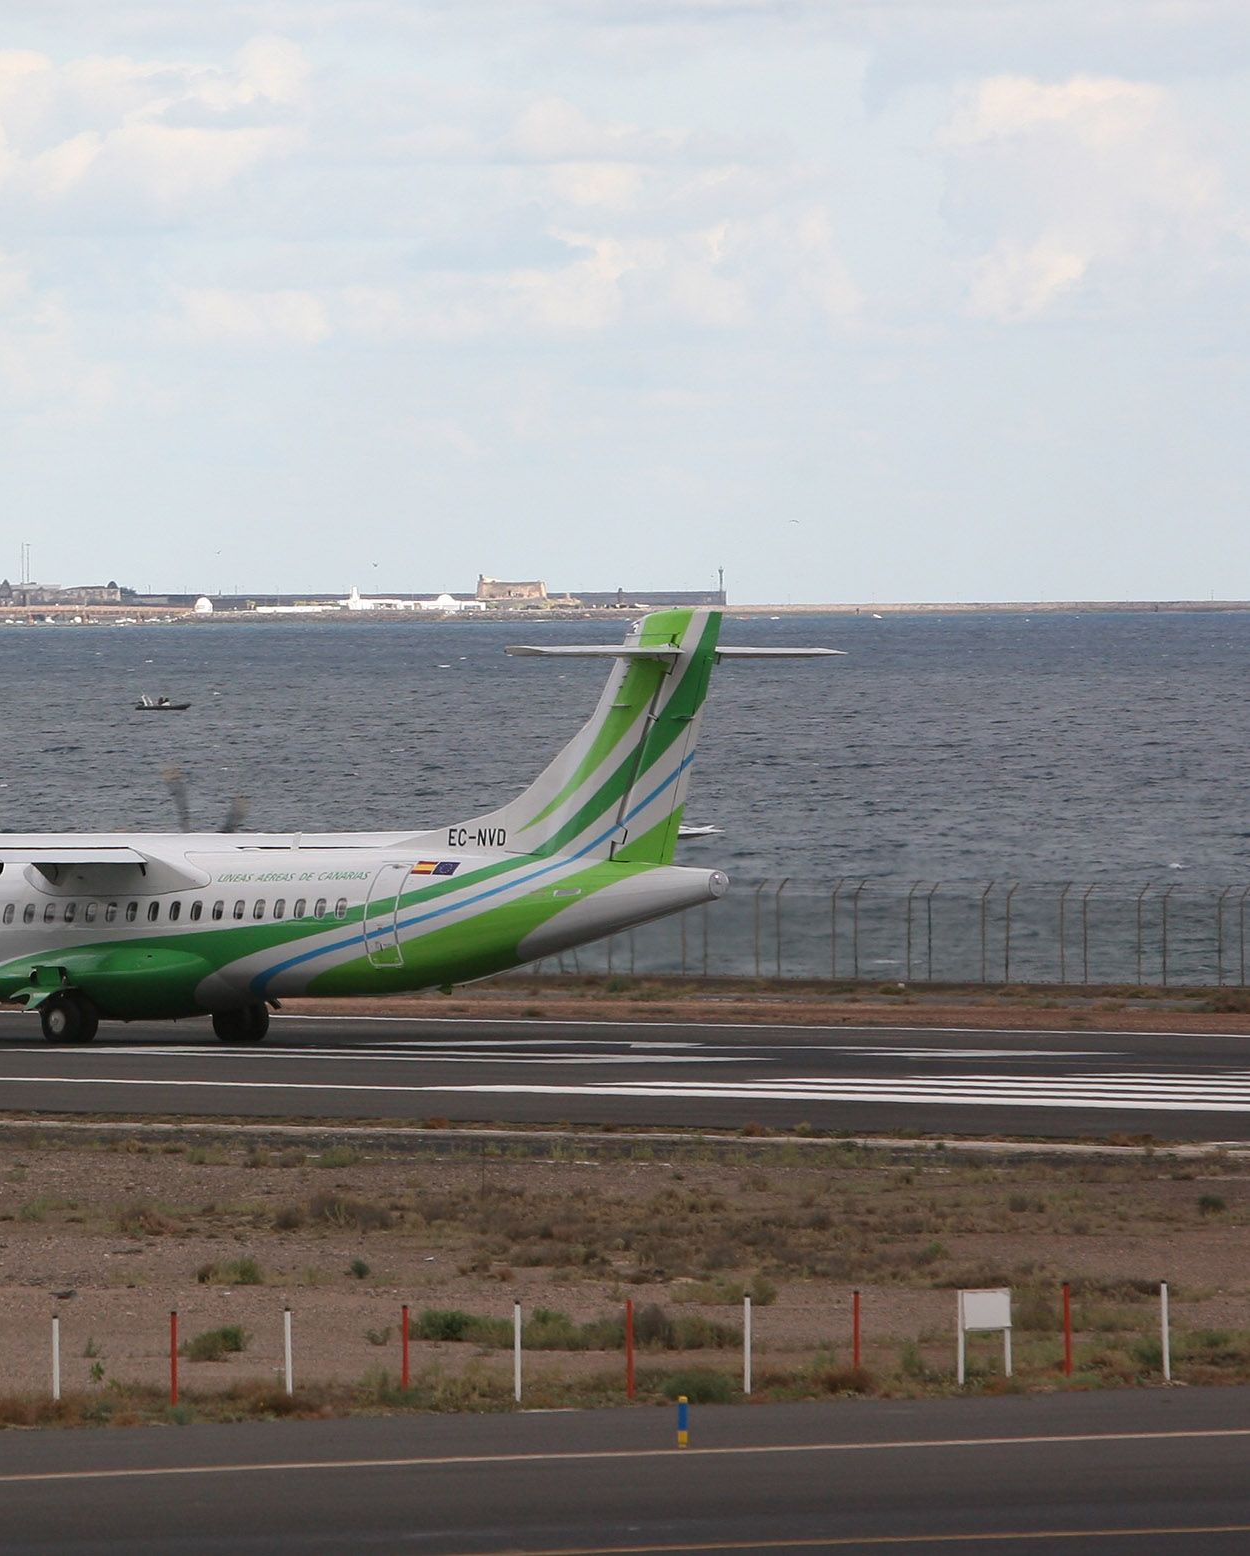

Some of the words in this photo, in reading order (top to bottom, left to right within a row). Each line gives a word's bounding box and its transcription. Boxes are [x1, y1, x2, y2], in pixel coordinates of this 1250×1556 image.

[448, 828, 507, 847] EC-NVD
[299, 872, 316, 882] DE
[317, 871, 371, 881] CANARIAS
